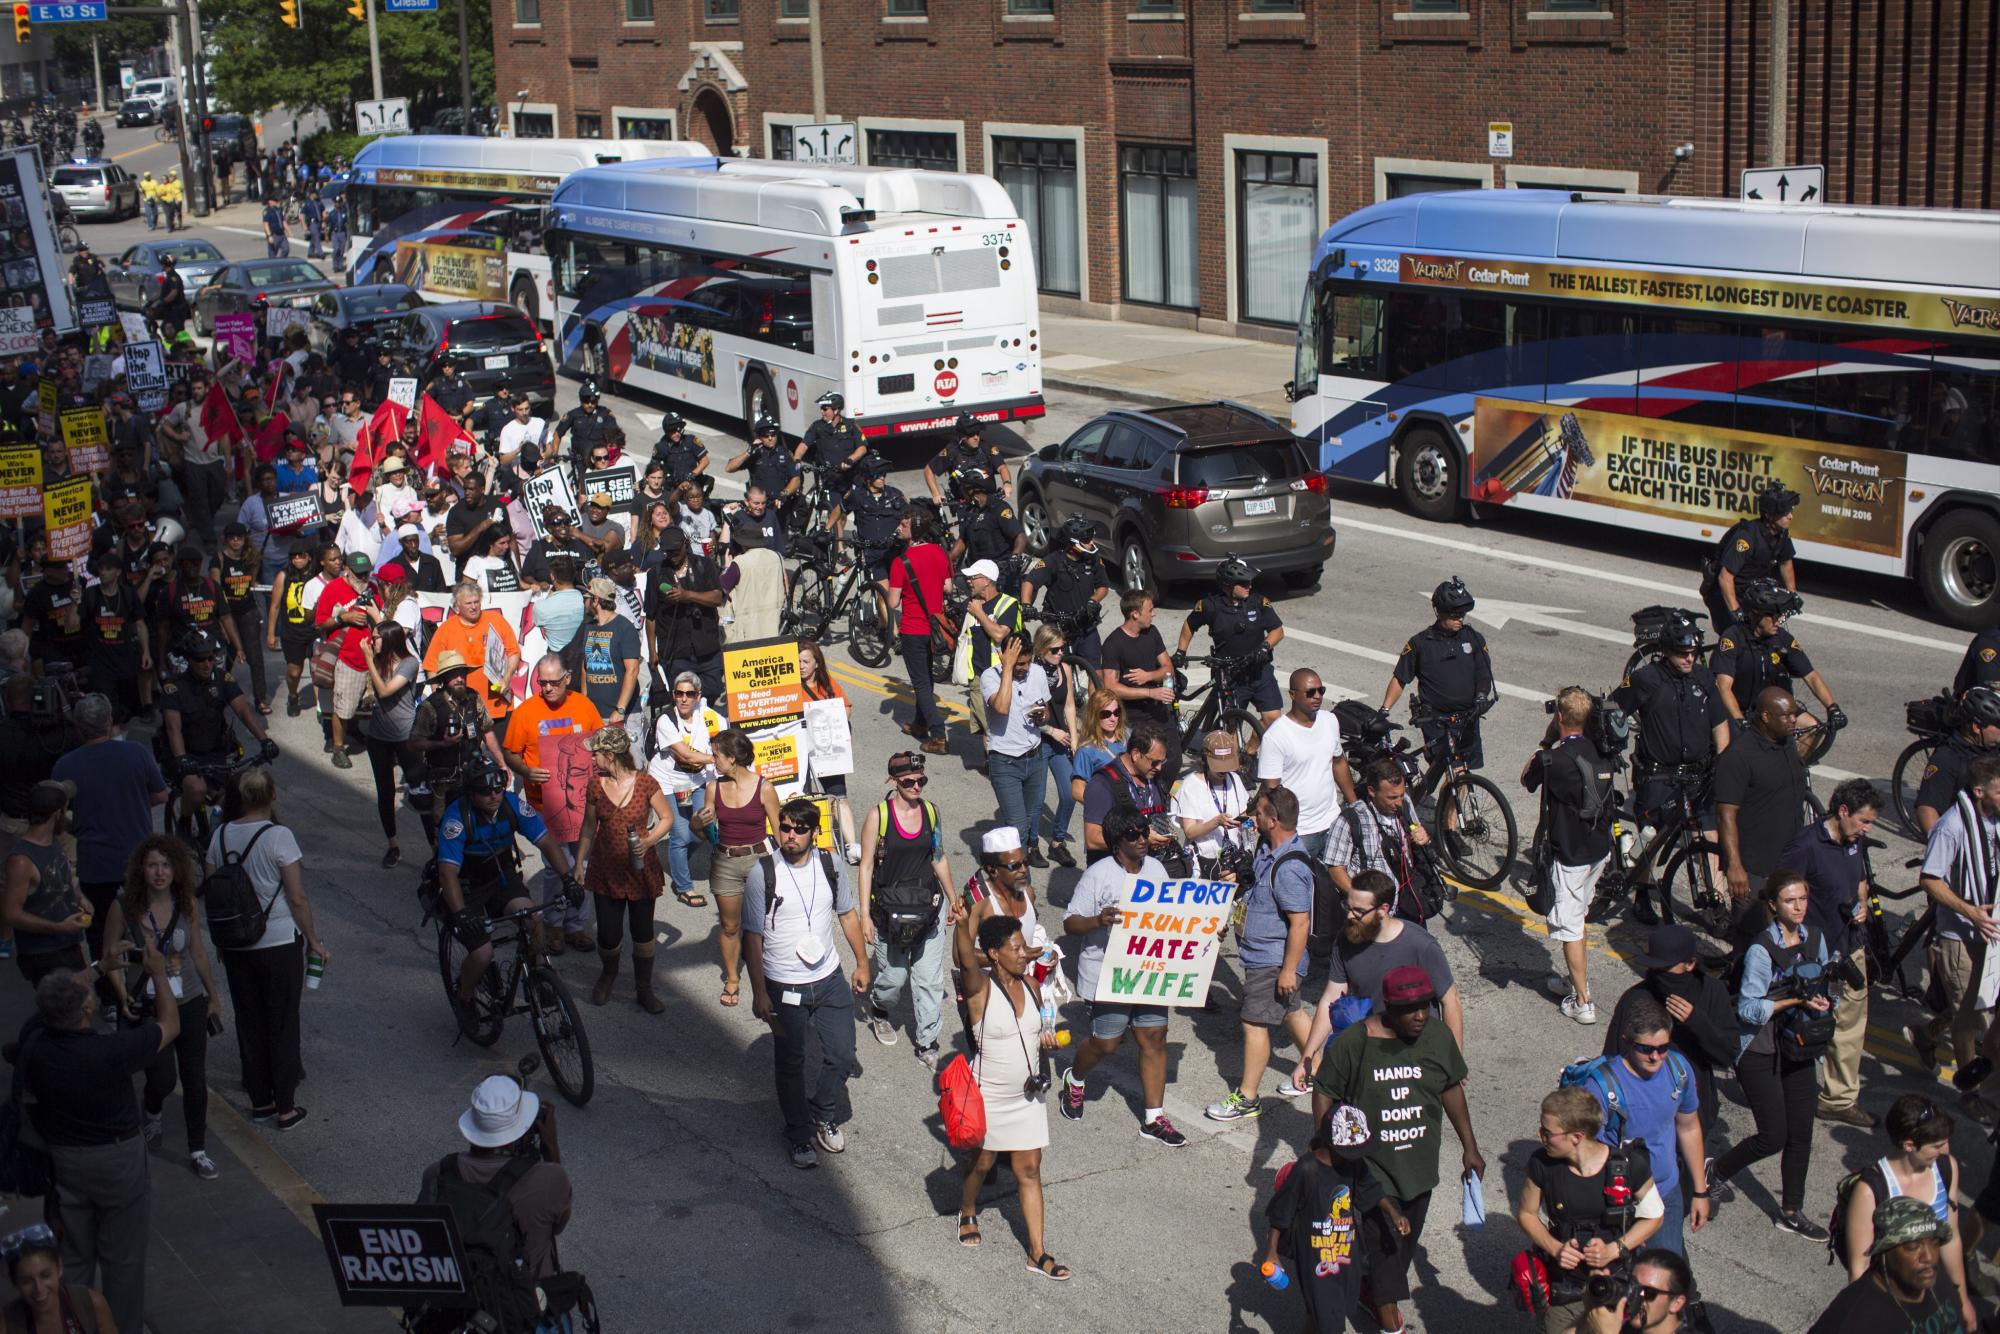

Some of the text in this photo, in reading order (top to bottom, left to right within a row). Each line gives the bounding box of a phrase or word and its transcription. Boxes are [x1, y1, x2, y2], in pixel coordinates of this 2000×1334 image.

[40, 5, 97, 19] E. 13 St
[982, 232, 1013, 246] 3374
[1374, 257, 1399, 273] 3329
[1468, 267, 1499, 283] Cedar
[1501, 269, 1530, 286] Point
[1549, 272, 1576, 290] THE
[1706, 285, 1779, 308] LONGEST
[1782, 292, 1823, 312] DIVE
[1826, 295, 1910, 320] COASTER.
[127, 346, 150, 361] Stop
[668, 347, 681, 361] OUT
[682, 350, 704, 368] THERE
[129, 360, 146, 373] the
[880, 375, 913, 392] STOP
[936, 378, 958, 390] RTA
[788, 387, 798, 401] RTA
[67, 414, 98, 422] America
[70, 427, 101, 438] NEVER
[81, 446, 97, 455] Need
[1622, 435, 1774, 475] IF THE BUS ISN'T
[1606, 453, 1691, 485] EXCITING
[1819, 455, 1880, 477] Cedar Point
[4, 477, 31, 485] Great!
[527, 478, 554, 499] Stop
[586, 477, 631, 494] WE SEE
[1802, 464, 1894, 505] VALRAVN
[9, 486, 28, 496] Need
[52, 485, 84, 500] America
[1608, 473, 1761, 515] CATCH THIS TRAI
[15, 503, 43, 513] System!
[61, 497, 77, 505] Was
[273, 499, 311, 512] POVERTY
[290, 503, 316, 514] CRIME
[53, 501, 86, 518] NEVER
[1821, 504, 1872, 521] NEW IN 2016
[59, 513, 82, 526] Great!
[50, 528, 63, 539] We
[64, 525, 81, 535] Need
[51, 532, 91, 549] OVERTHROW
[52, 548, 68, 559] This
[741, 654, 784, 668] America
[732, 663, 795, 680] Was NEVER
[749, 676, 781, 688] Great!
[737, 689, 771, 701] We Need
[737, 693, 798, 709] to OVERTHROW
[739, 703, 788, 718] This System!
[740, 714, 798, 729] www.revcom.us
[763, 743, 786, 751] America
[769, 746, 792, 756] NEVER
[767, 754, 785, 762] Great!
[1131, 879, 1235, 905] DEPORT
[1120, 911, 1220, 934] TRUMP'S
[1127, 935, 1198, 960] HATE
[1141, 960, 1166, 971] HIS
[1112, 967, 1199, 998] WIFE
[1373, 1066, 1422, 1081] HANDS
[1391, 1087, 1410, 1101] UP
[1381, 1106, 1423, 1122] DON'T
[1380, 1126, 1427, 1142] SHOOT
[1907, 1223, 1937, 1235] ICONS
[359, 1228, 422, 1254] END
[342, 1256, 459, 1282] RACISM
